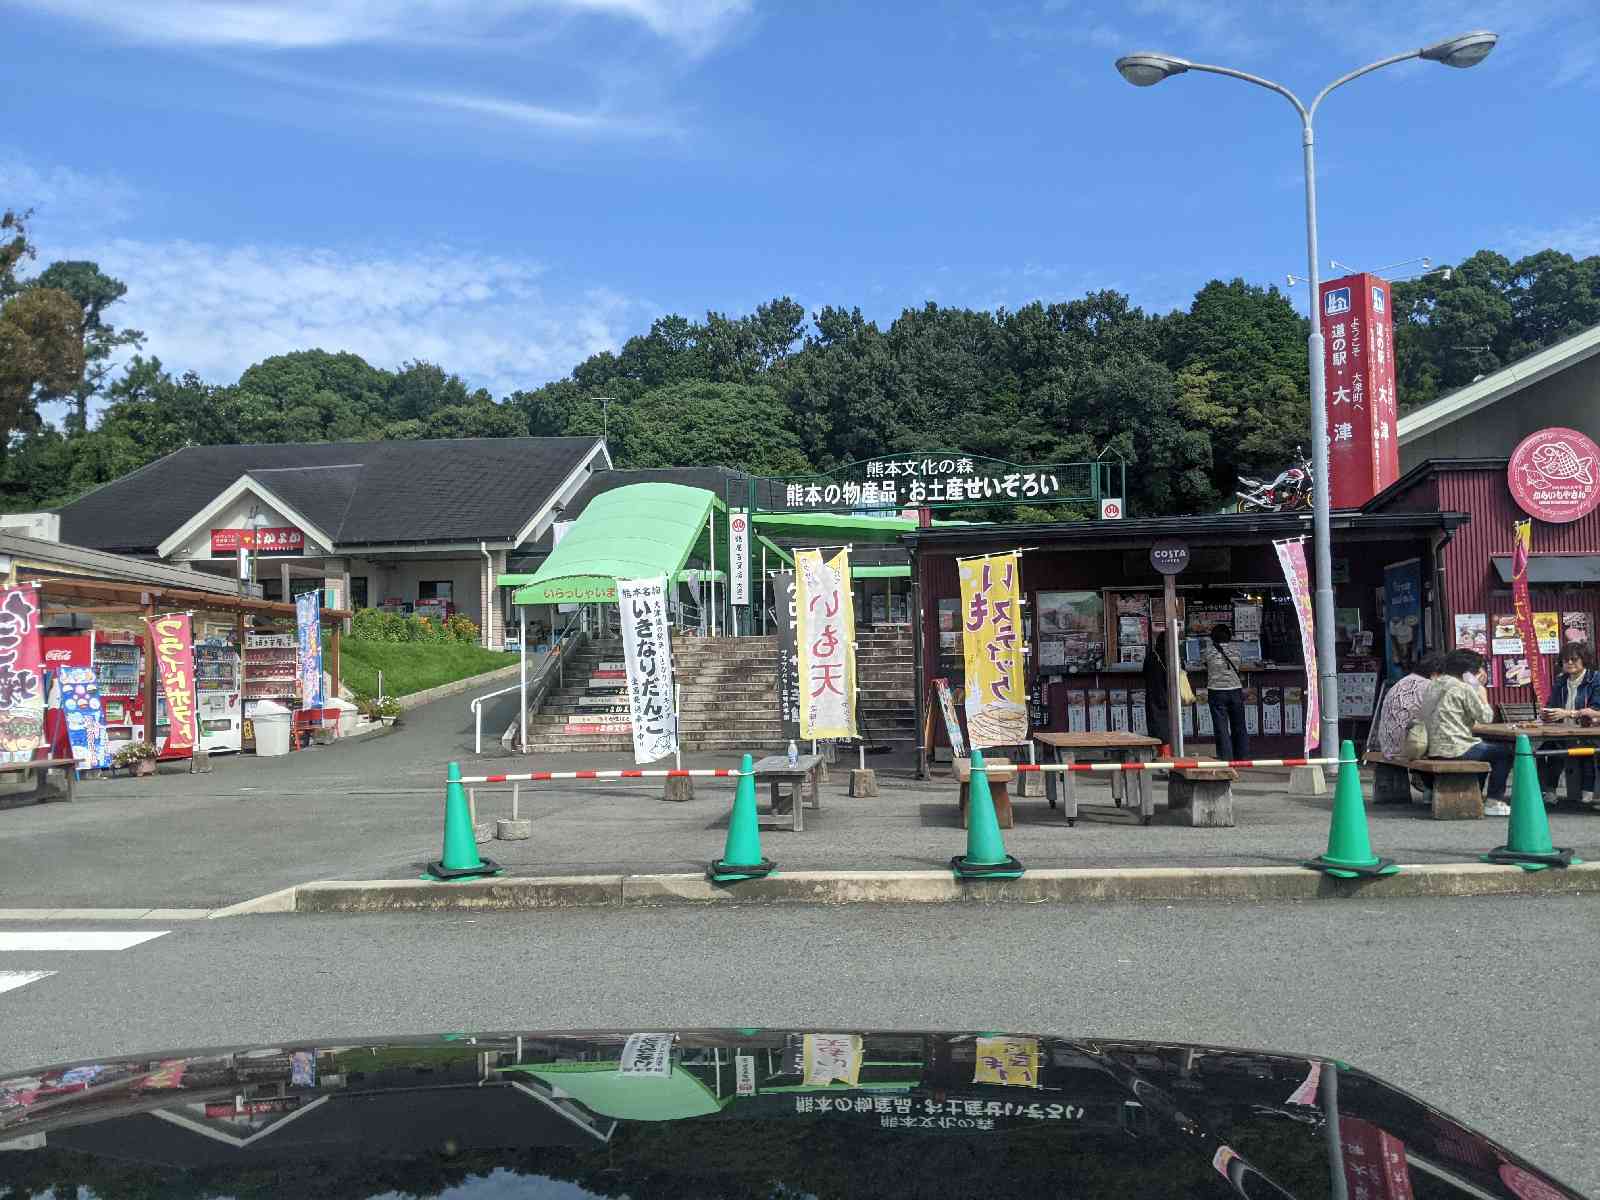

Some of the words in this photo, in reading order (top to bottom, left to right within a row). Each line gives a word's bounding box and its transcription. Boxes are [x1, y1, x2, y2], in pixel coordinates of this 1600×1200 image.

[1351, 316, 1361, 357] ようこそ
[1352, 373, 1364, 411] 大津町へ
[867, 457, 975, 478] 熊本文化の森
[786, 473, 1060, 507] 熊本の物産品・お土産せいぞろい
[1154, 549, 1186, 558] COSTA
[543, 587, 616, 598] いらっしゃいま
[632, 600, 664, 735] いきなりだんご
